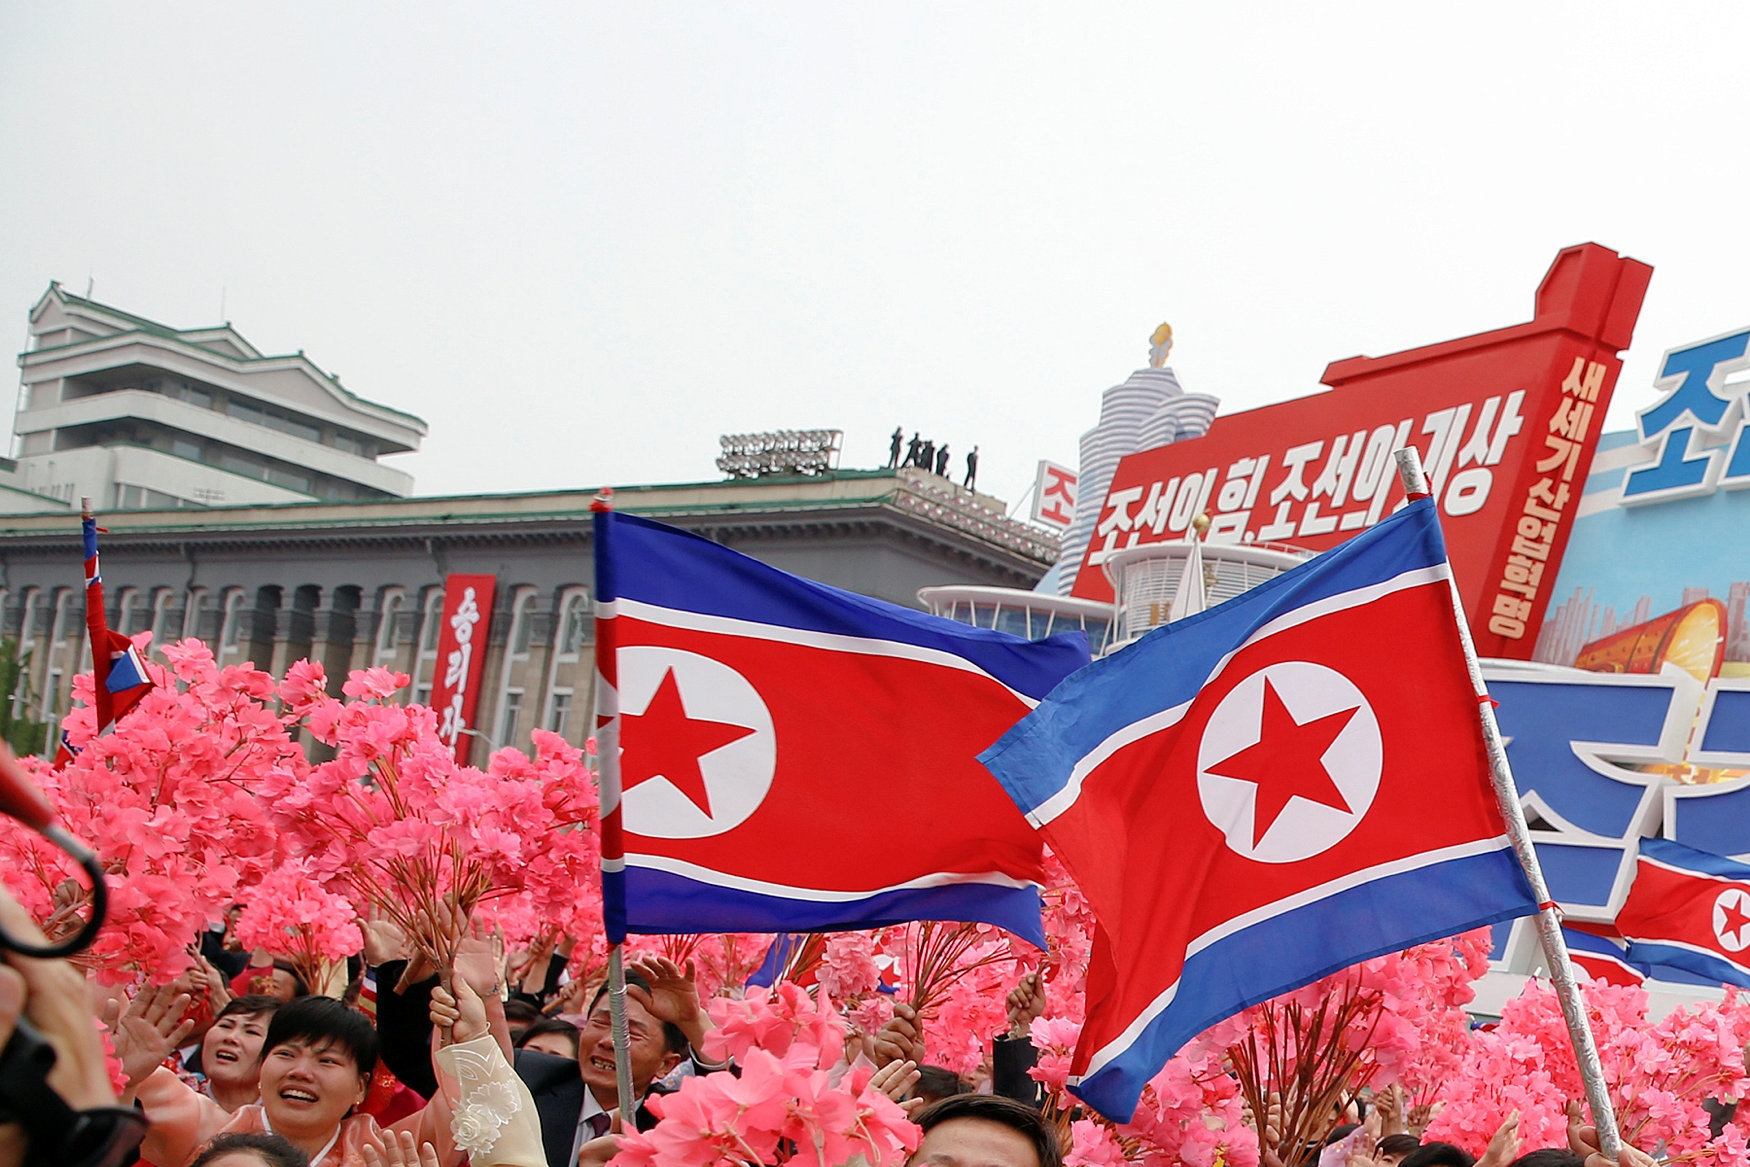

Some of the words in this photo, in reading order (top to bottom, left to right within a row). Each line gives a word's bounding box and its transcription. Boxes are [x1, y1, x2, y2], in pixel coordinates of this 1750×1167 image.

[1257, 417, 1414, 541] 조선의
[1488, 356, 1607, 640] 새세기산업혁명
[438, 586, 481, 757] 승리자
